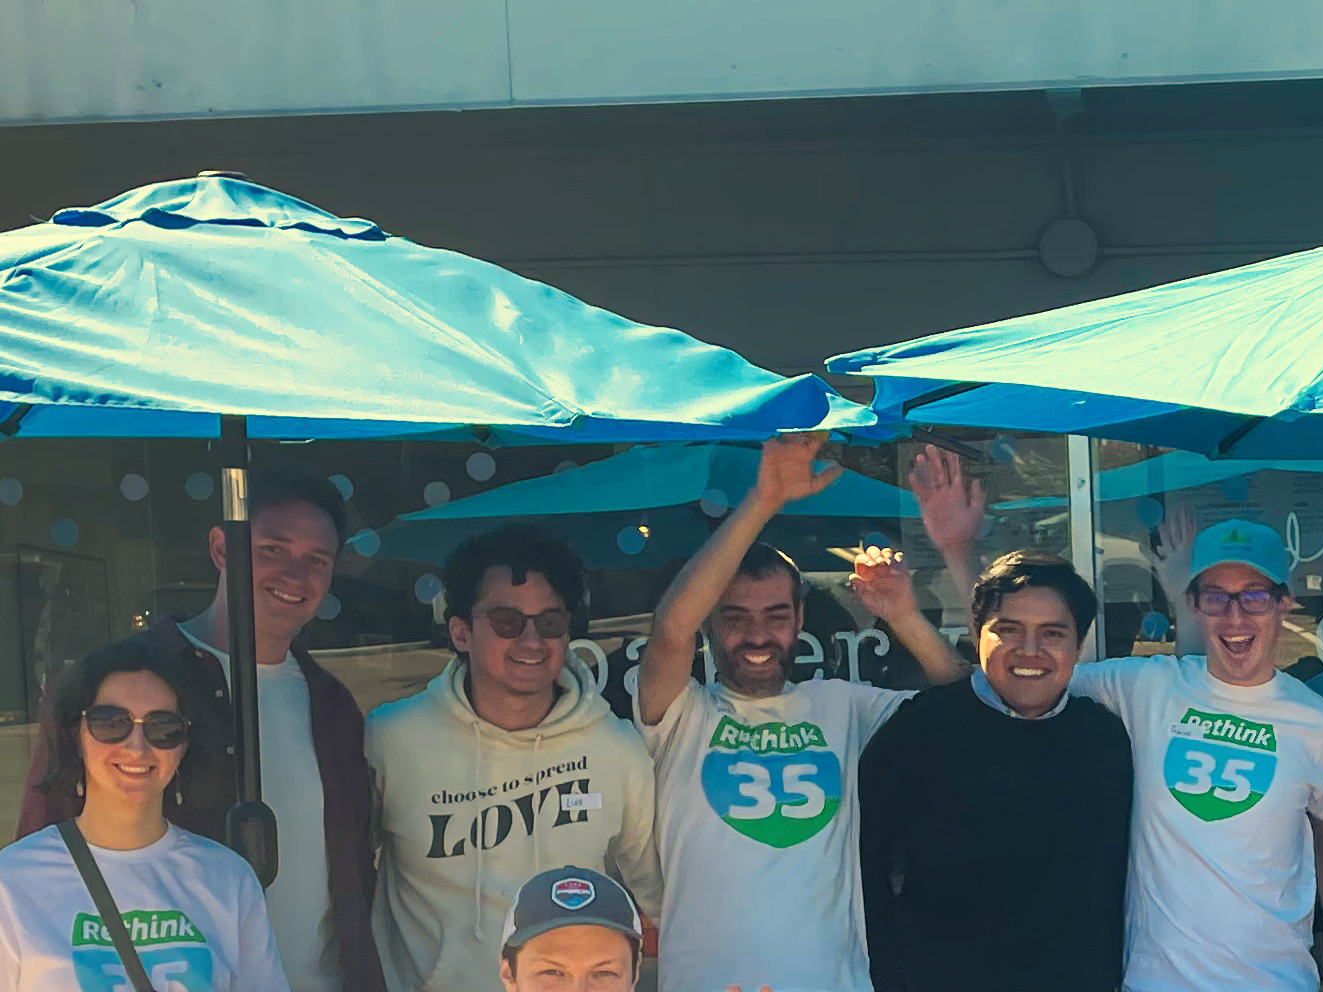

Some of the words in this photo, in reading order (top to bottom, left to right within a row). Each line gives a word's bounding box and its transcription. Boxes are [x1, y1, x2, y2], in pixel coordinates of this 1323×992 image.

[1187, 715, 1272, 746] Rethink
[431, 785, 498, 805] choose
[502, 779, 520, 793] to
[523, 755, 588, 786] spread
[727, 761, 826, 820] 35
[1174, 750, 1255, 803] 35
[425, 778, 591, 858] LOVE
[82, 914, 195, 942] Rehink
